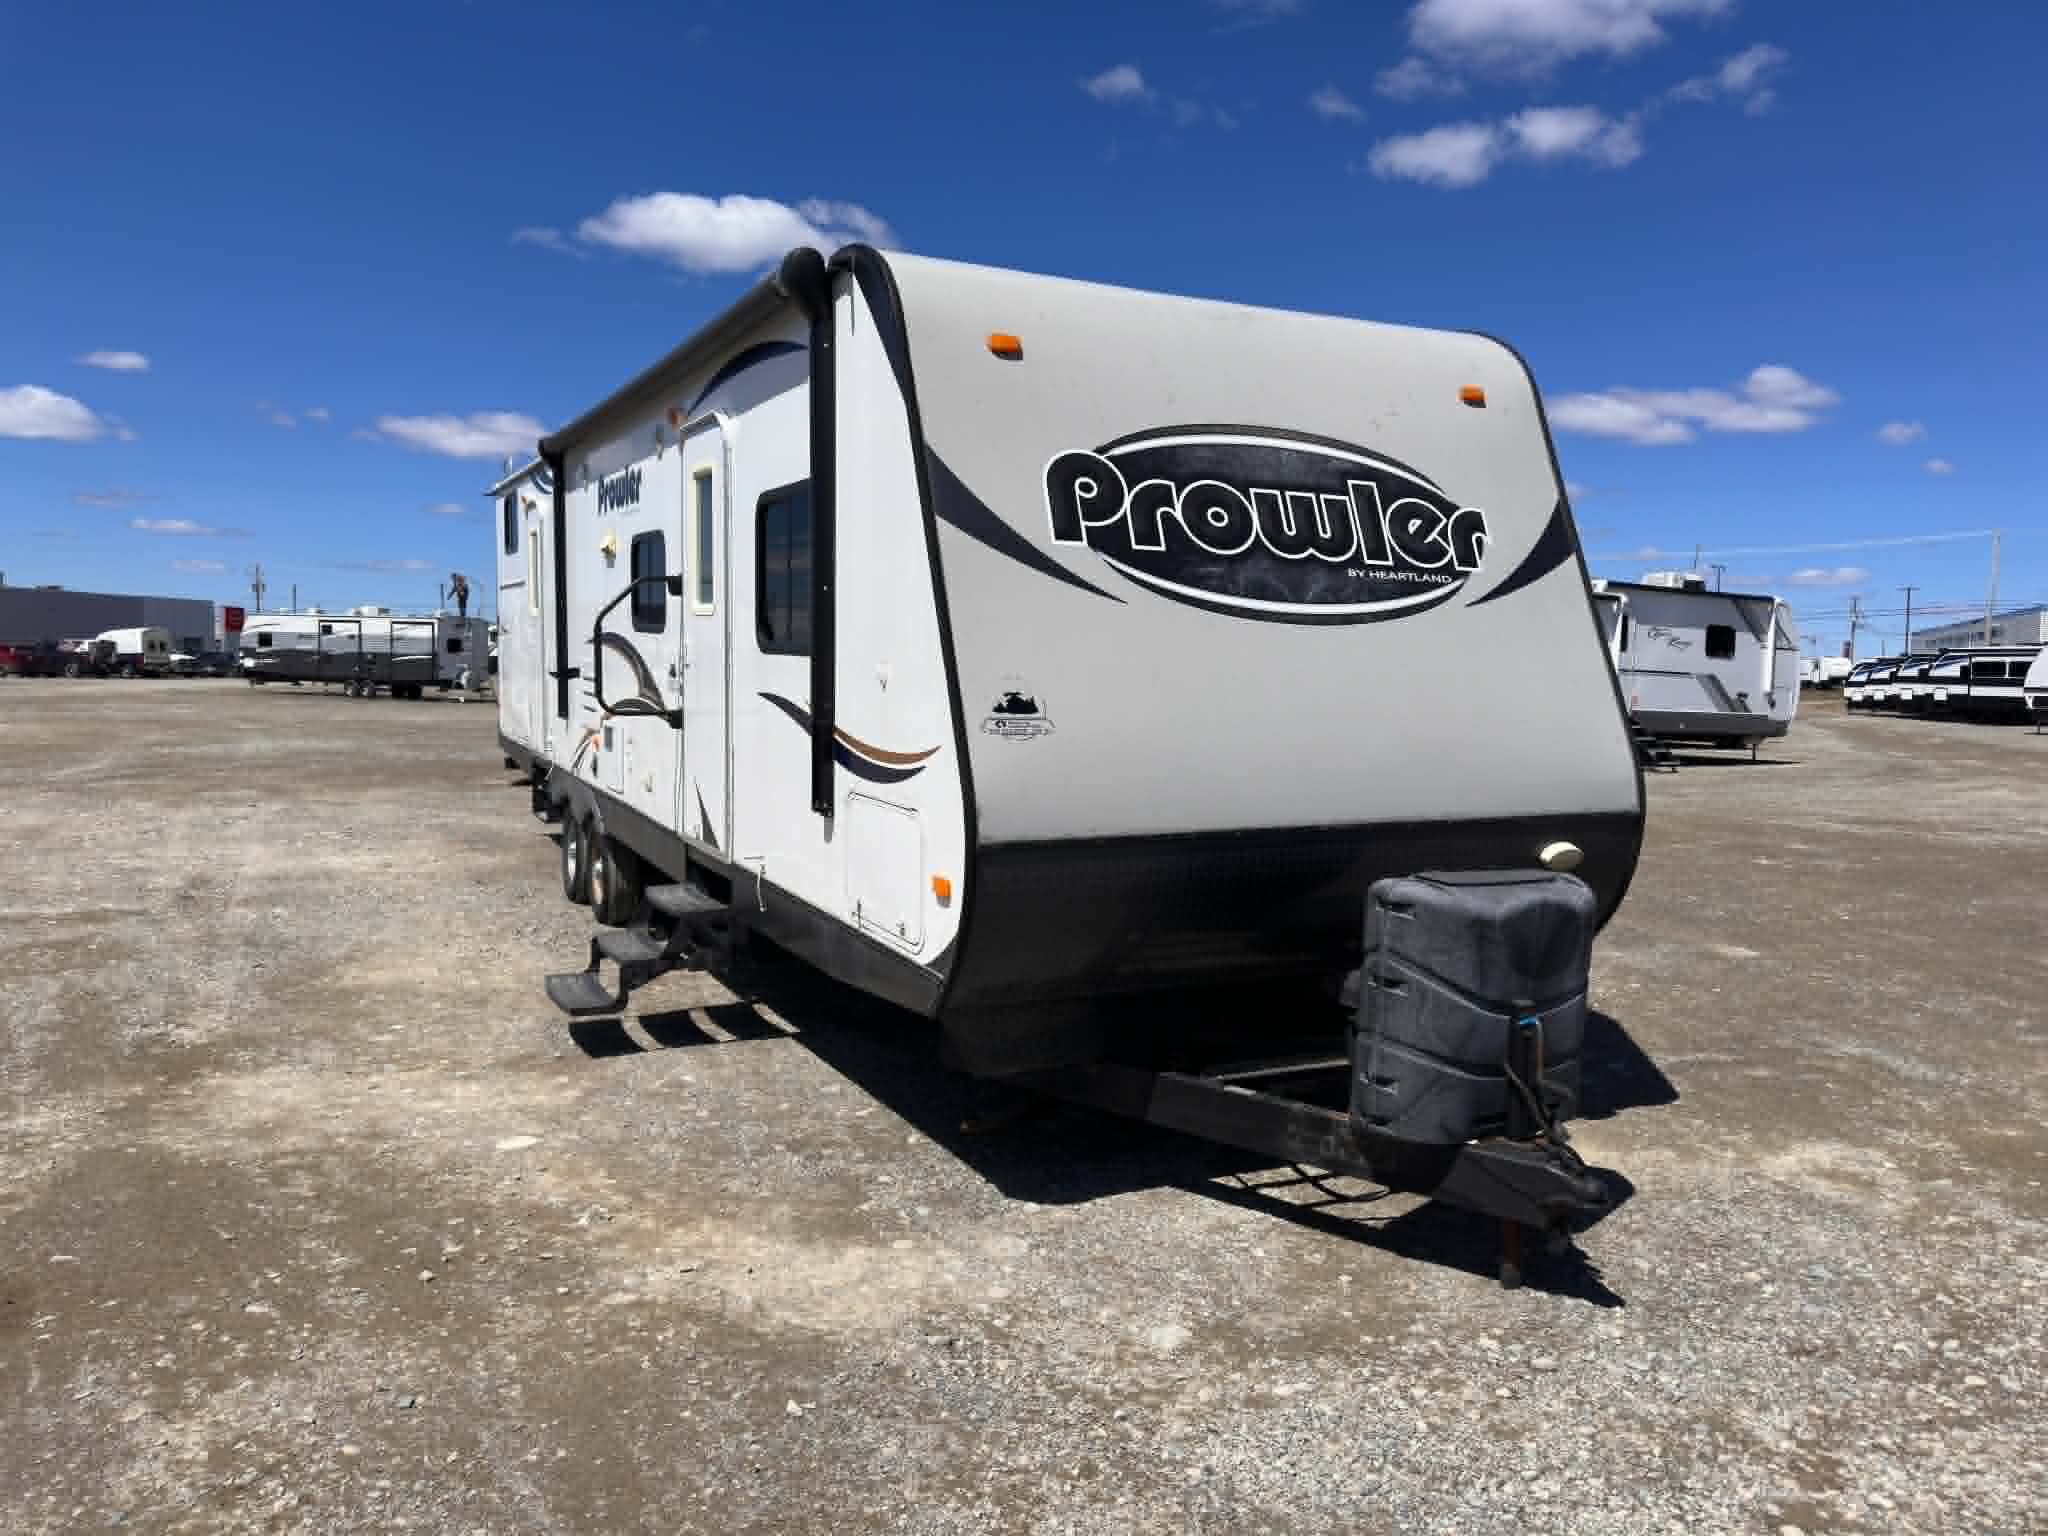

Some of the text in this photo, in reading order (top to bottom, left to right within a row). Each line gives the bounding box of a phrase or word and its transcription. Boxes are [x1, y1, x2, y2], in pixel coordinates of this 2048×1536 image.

[597, 464, 642, 516] Prowler
[1044, 450, 1488, 571] Prowler
[1347, 567, 1452, 584] BY HEARTLAND
